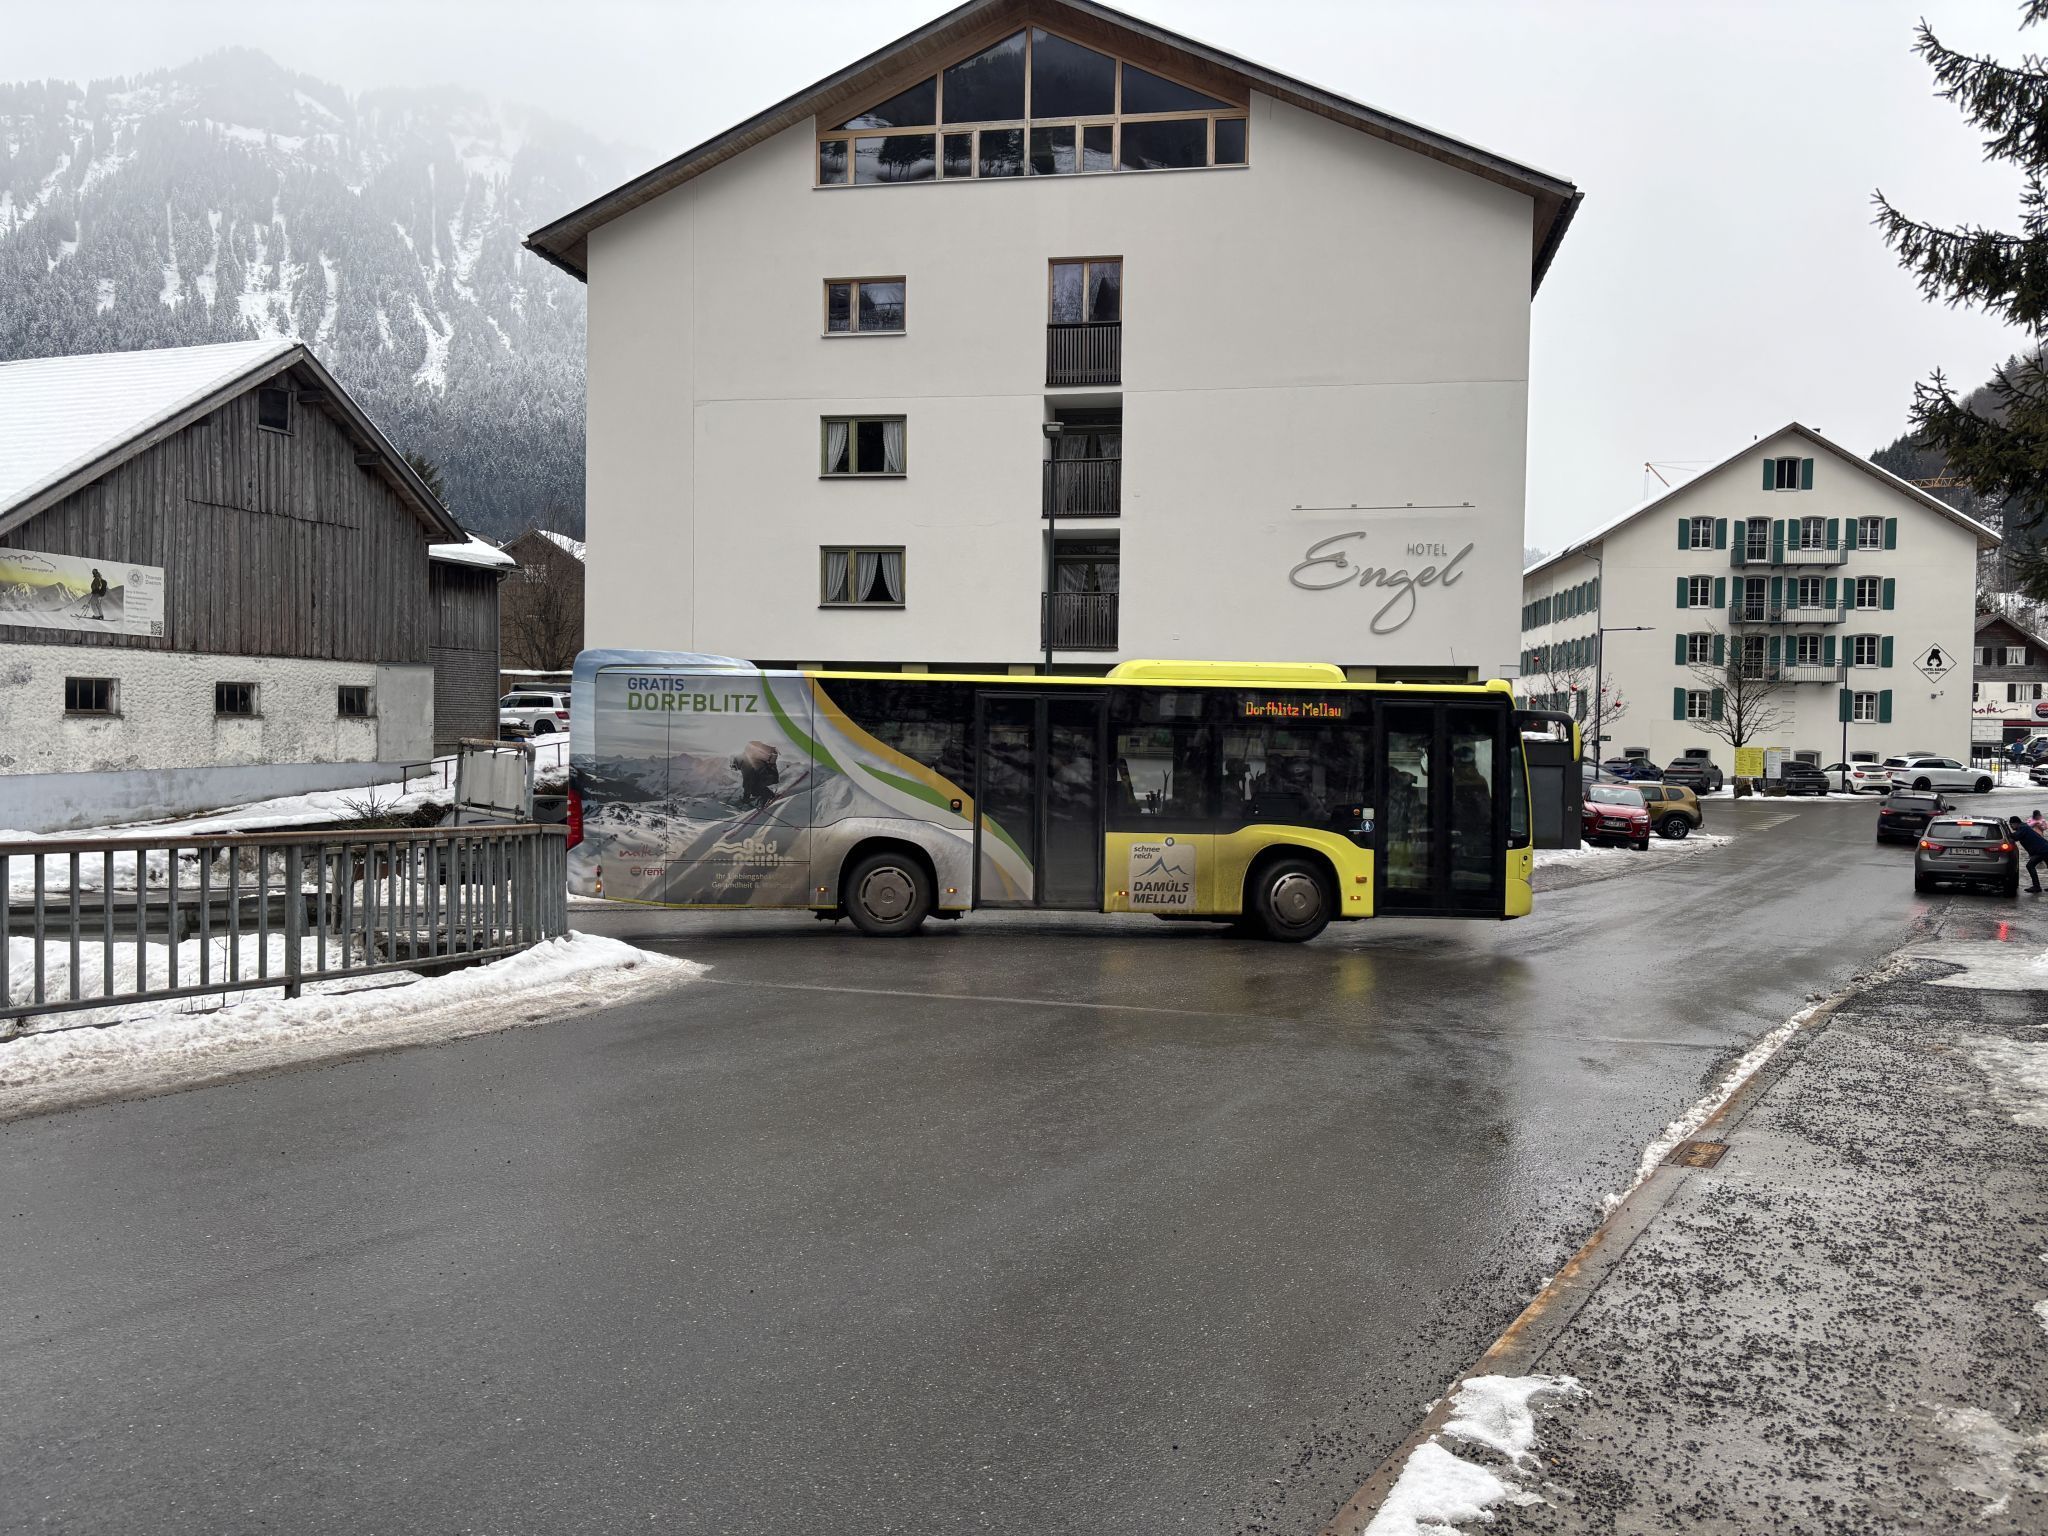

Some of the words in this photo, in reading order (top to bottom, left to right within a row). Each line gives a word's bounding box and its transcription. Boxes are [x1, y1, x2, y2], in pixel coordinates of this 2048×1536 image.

[1407, 543, 1447, 556] HOTEL
[1289, 531, 1474, 635] Engel
[628, 677, 684, 691] GRATIS
[628, 692, 758, 713] DORFBLITZ
[1245, 701, 1299, 716] Dorfblitz
[1302, 702, 1342, 717] Mellau
[1134, 852, 1153, 860] reich
[643, 867, 665, 876] rent
[711, 881, 753, 889] Geundheit
[1133, 880, 1190, 893] DAMÜLS
[1133, 893, 1187, 905] MELLAU
